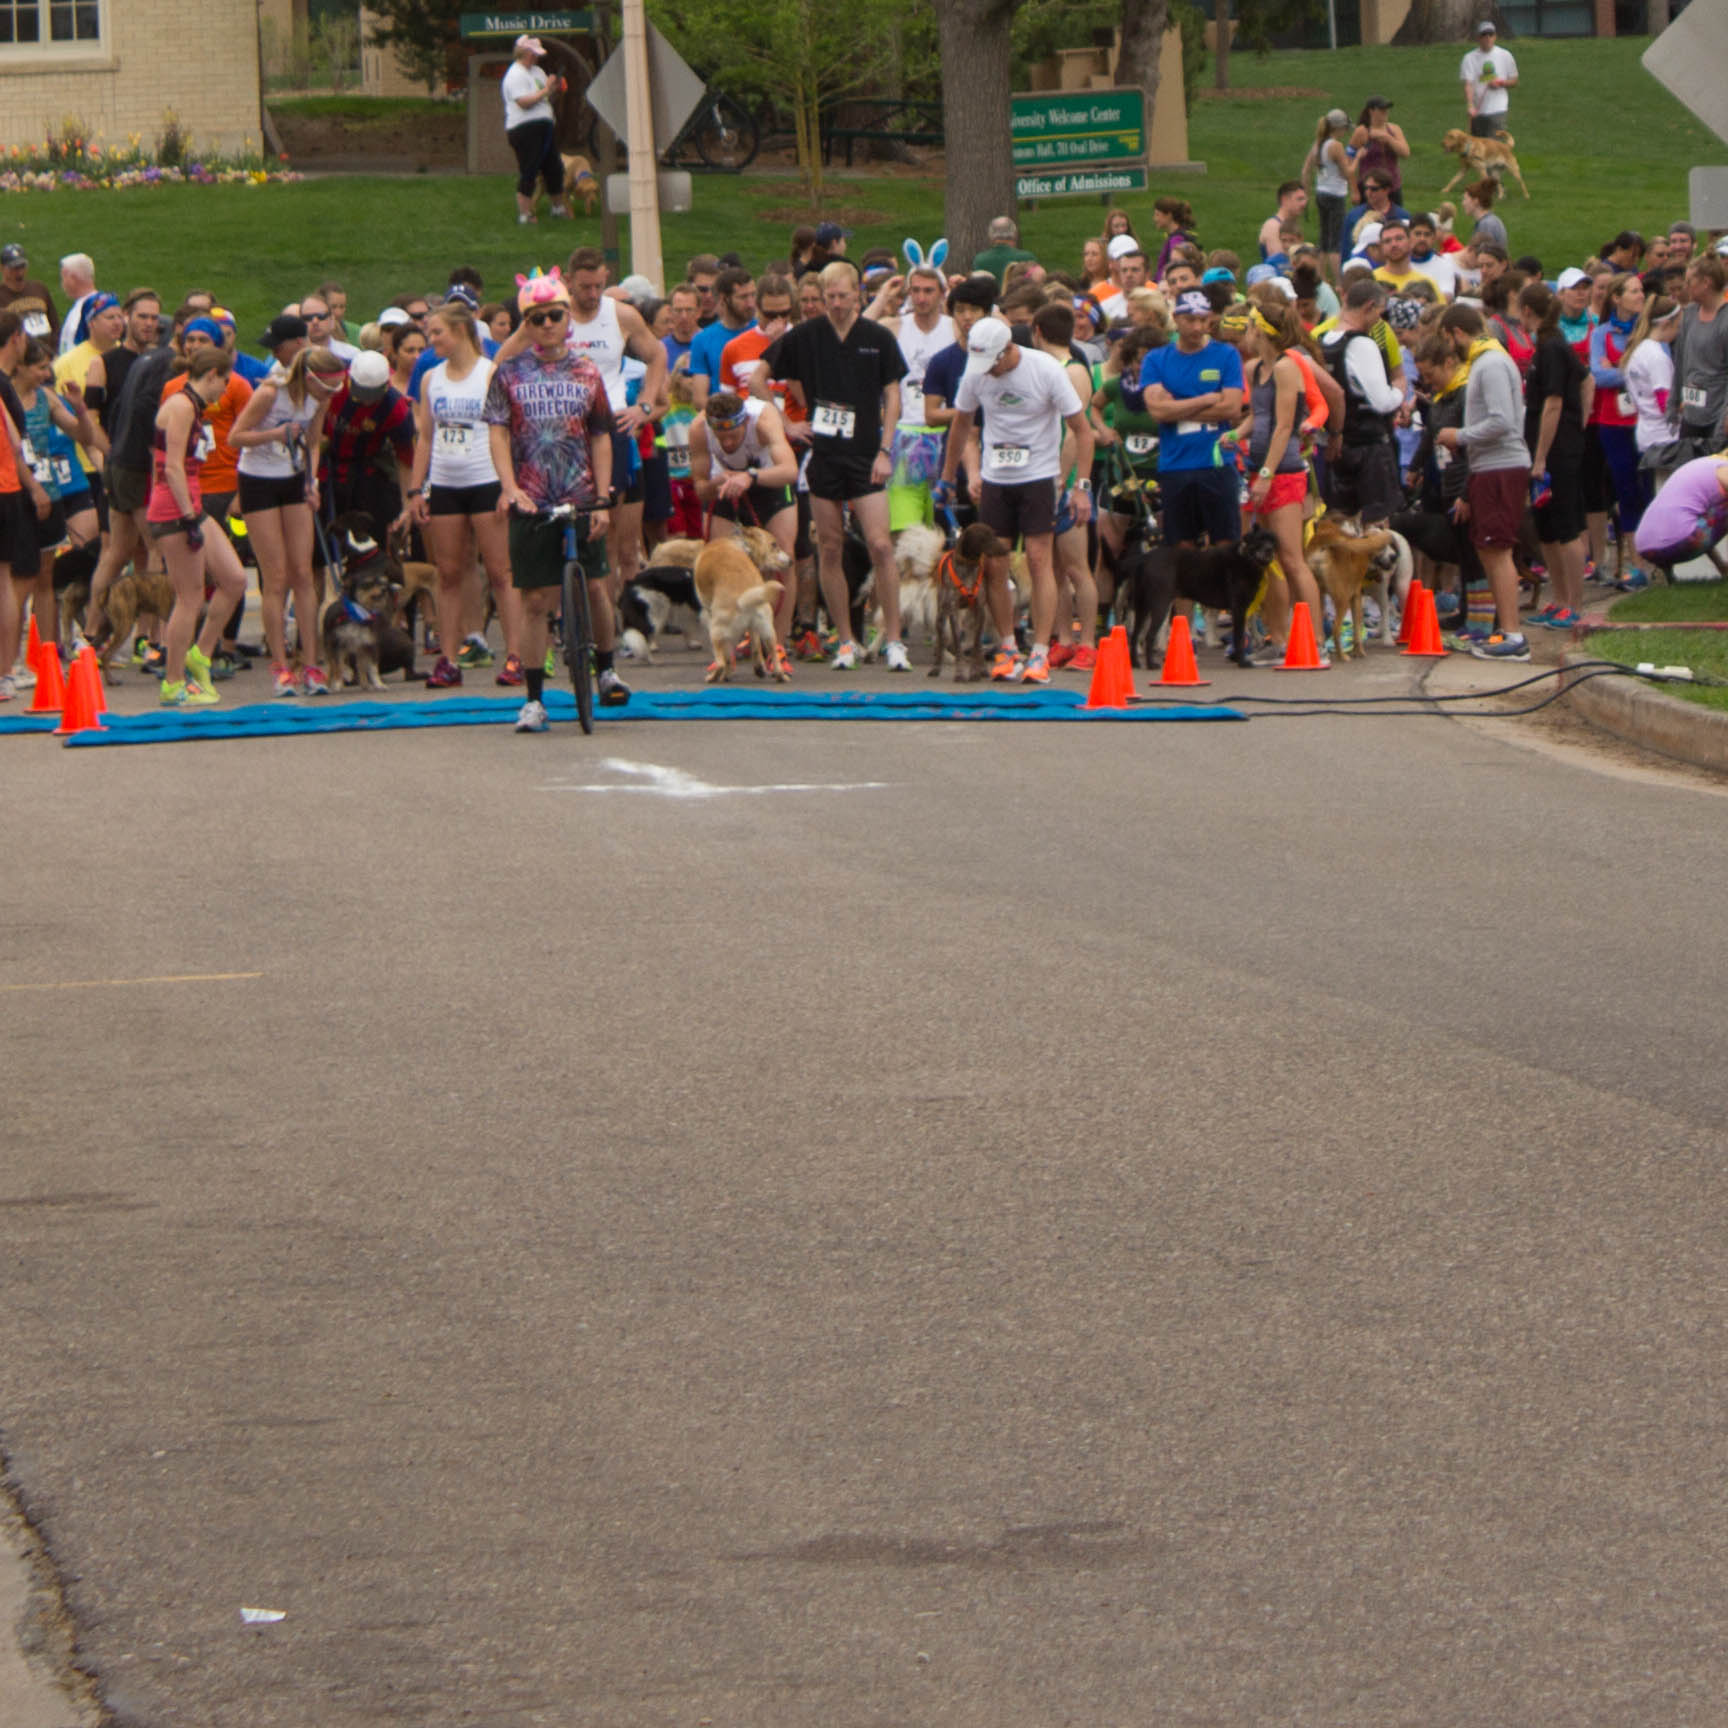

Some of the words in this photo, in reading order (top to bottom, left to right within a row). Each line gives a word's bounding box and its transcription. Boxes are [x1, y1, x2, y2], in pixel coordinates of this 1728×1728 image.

[484, 15, 527, 31] Music
[530, 14, 572, 29] Drive
[1011, 111, 1047, 129] iversity
[1049, 107, 1089, 125] Welcome
[1090, 105, 1121, 122] Center
[1089, 139, 1110, 153] Drive
[1018, 177, 1051, 194] Office
[1054, 176, 1066, 192] of
[1070, 173, 1132, 191] Admissions
[516, 382, 590, 401] FIREWORKS
[821, 410, 848, 426] 215
[441, 429, 466, 444] 473
